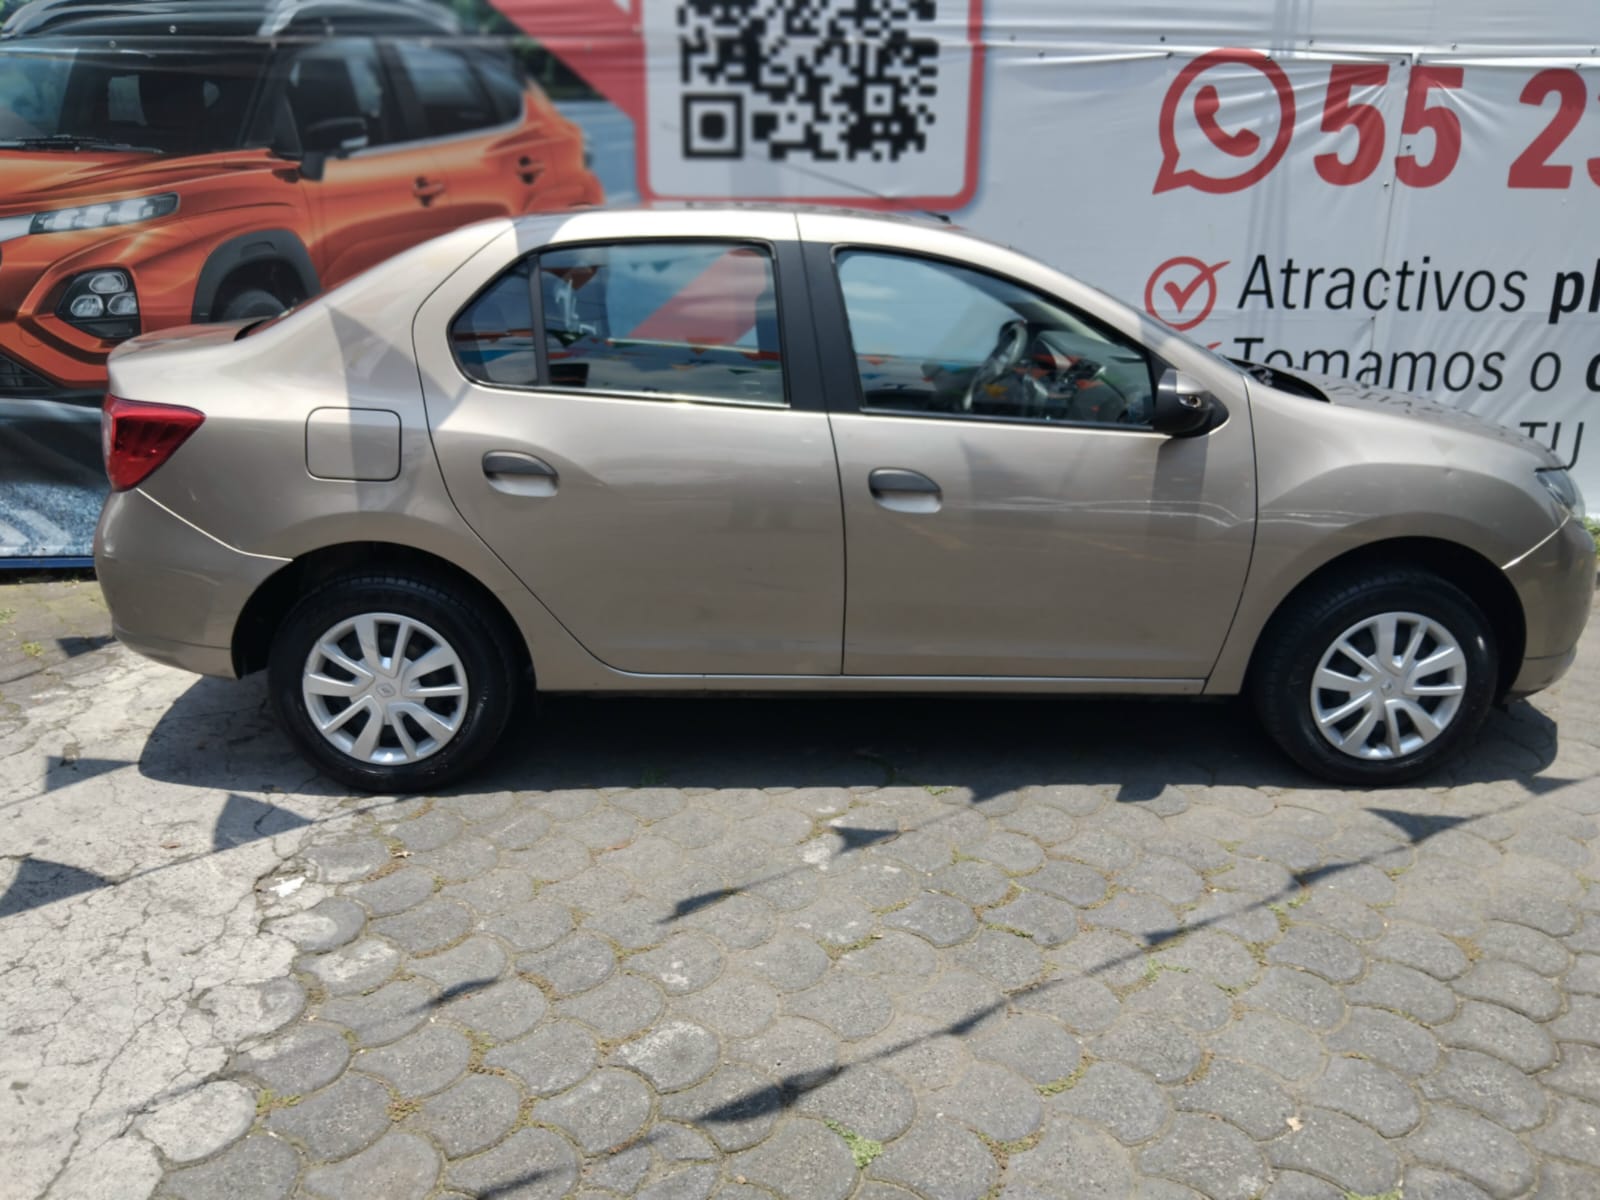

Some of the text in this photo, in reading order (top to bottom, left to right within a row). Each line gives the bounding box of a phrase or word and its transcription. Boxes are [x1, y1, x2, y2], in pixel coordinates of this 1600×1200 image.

[1313, 63, 1464, 189] 55
[1237, 254, 1528, 313] Atractivos
[1530, 351, 1562, 392] o
